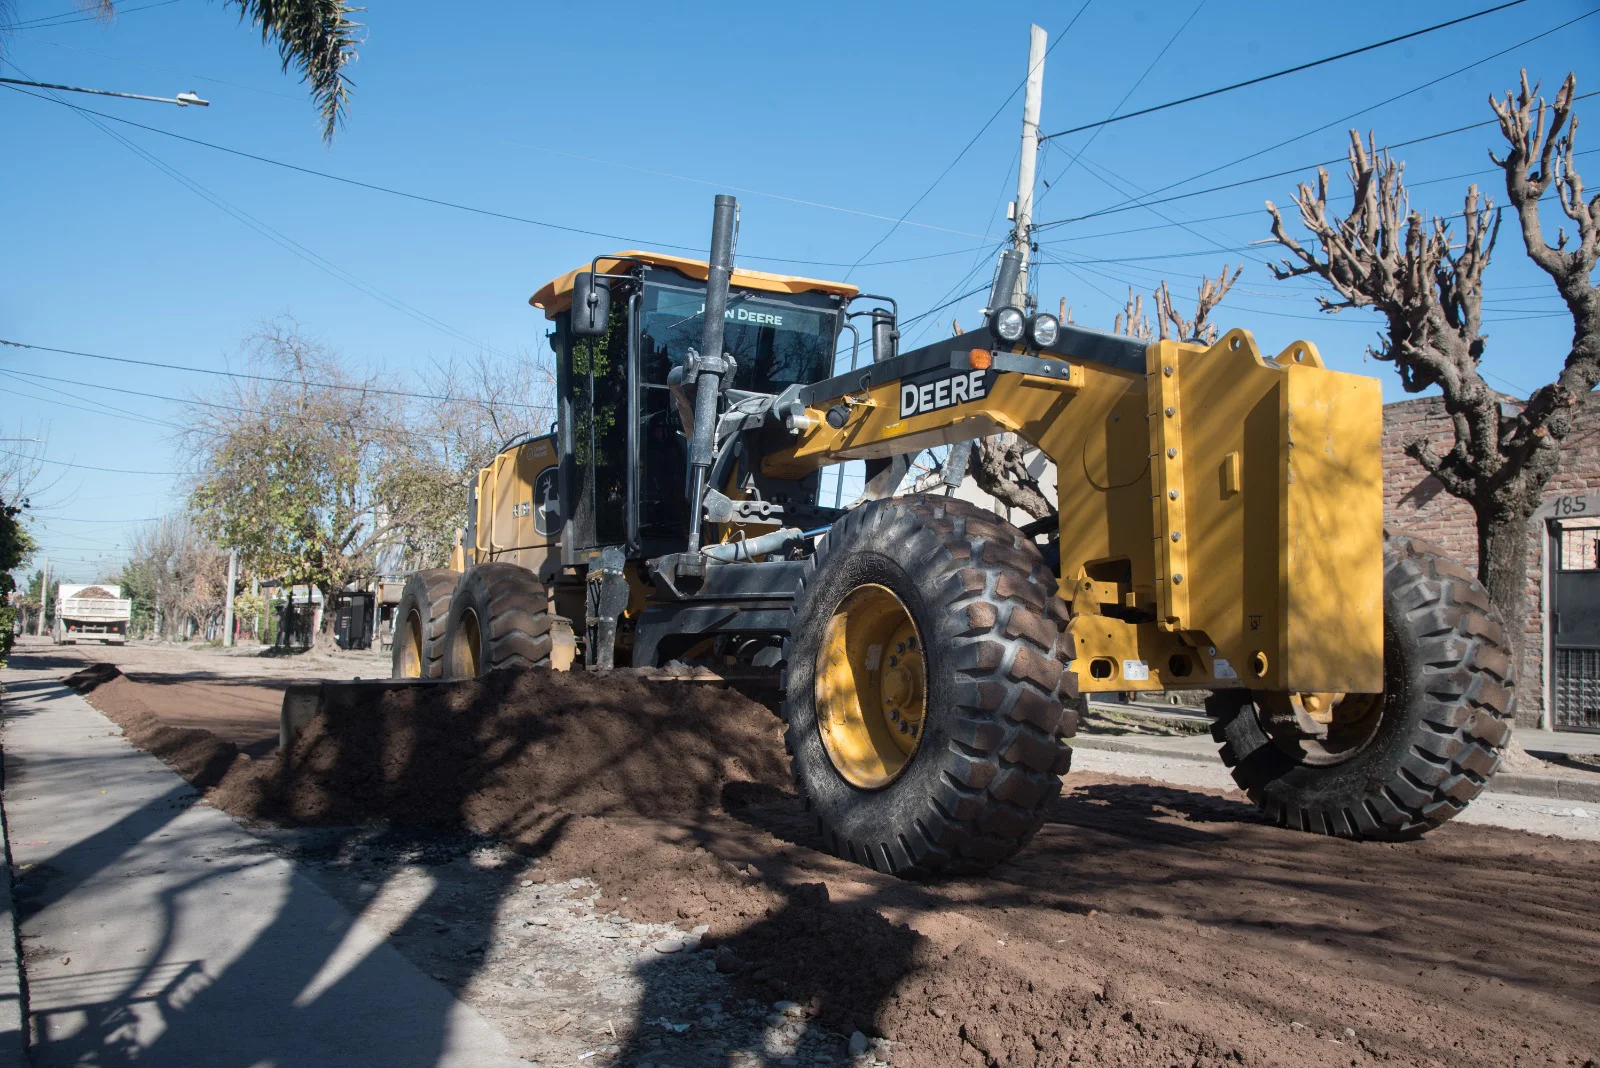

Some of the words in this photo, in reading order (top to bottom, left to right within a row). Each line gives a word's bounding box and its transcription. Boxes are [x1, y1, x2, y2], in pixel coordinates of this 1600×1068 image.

[697, 304, 735, 319] JN
[738, 309, 783, 325] DEERE
[901, 370, 986, 417] DEERE
[1553, 496, 1586, 516] 185
